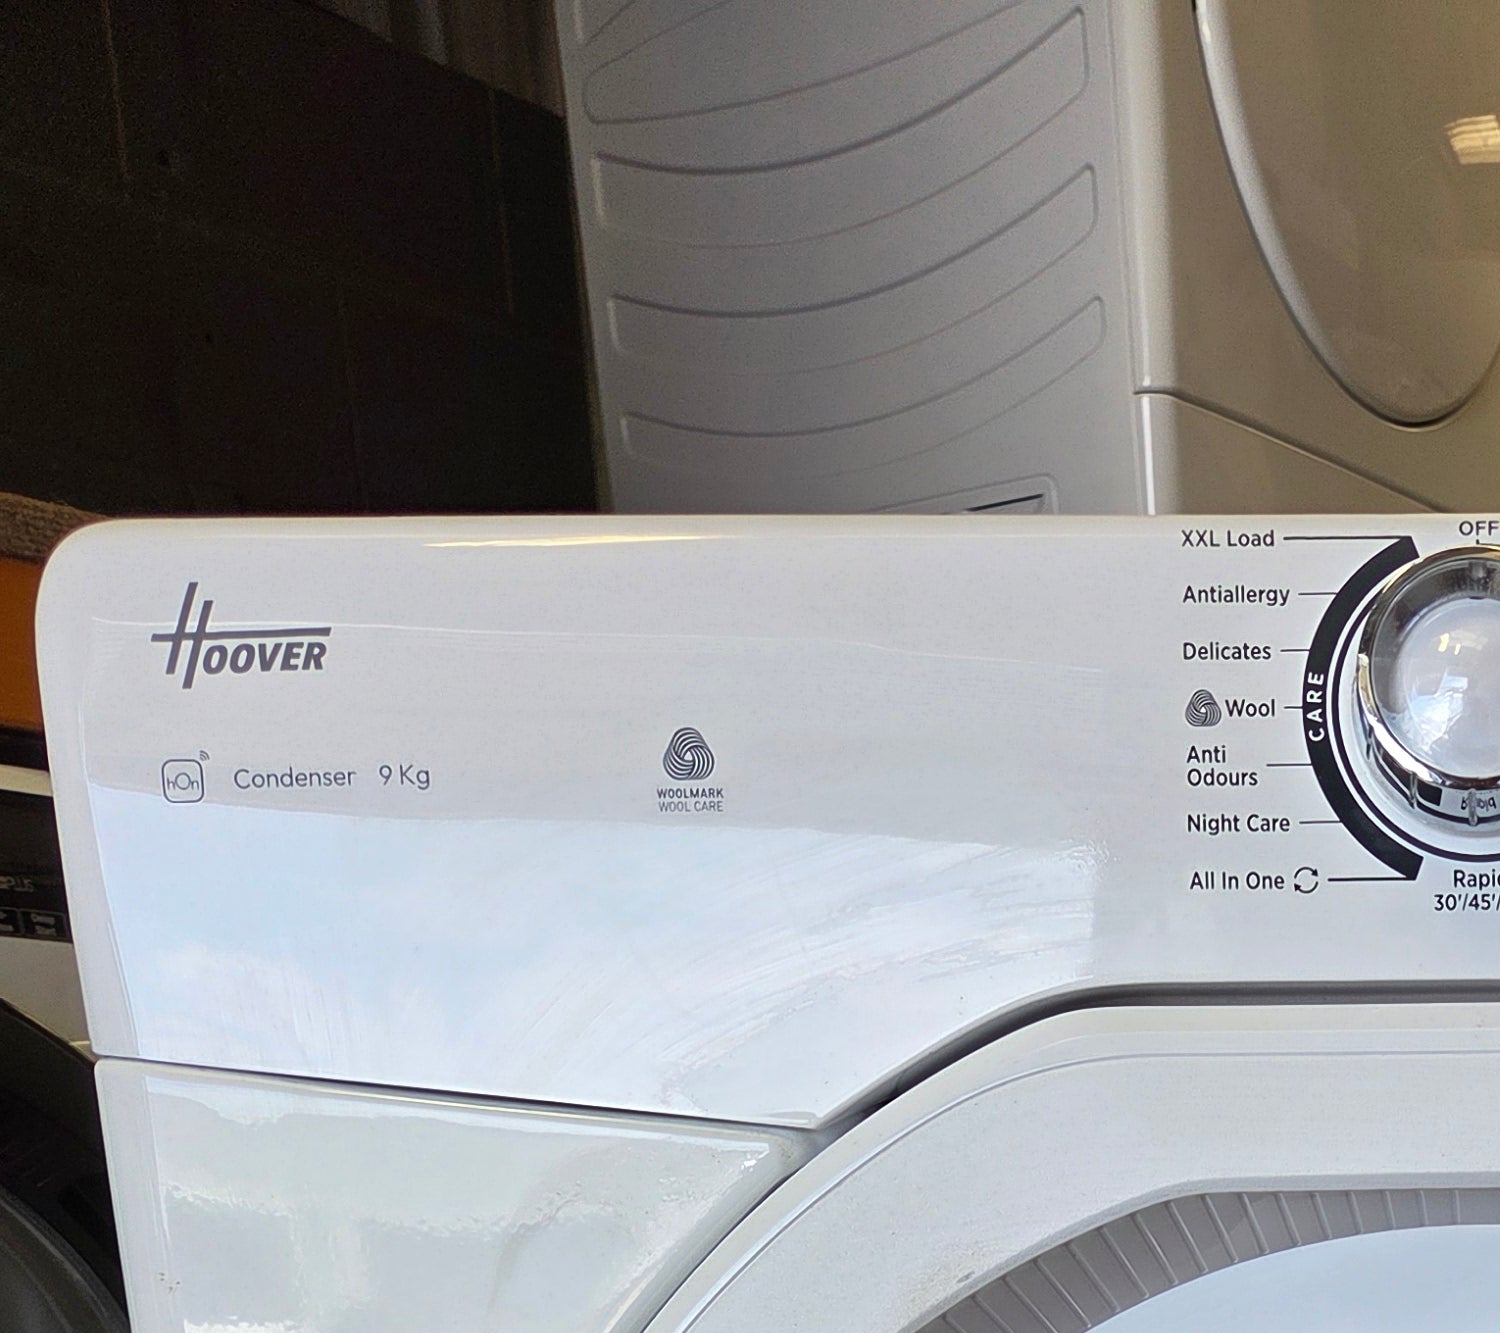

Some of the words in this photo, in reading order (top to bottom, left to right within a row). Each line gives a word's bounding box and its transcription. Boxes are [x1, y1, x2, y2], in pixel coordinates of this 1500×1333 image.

[1181, 529, 1220, 548] XXL
[1226, 529, 1275, 548] Load
[1458, 520, 1500, 537] OFF
[1182, 584, 1290, 607] Antiallergy
[150, 581, 332, 690] HOOVER
[1182, 641, 1272, 661] Delicates
[1224, 698, 1276, 718] Wool
[1306, 670, 1325, 742] CARE
[1186, 744, 1226, 764] Anti
[166, 771, 201, 792] hOn
[233, 765, 357, 790] Condenser
[378, 764, 393, 786] 9
[399, 764, 430, 791] Kg
[1187, 767, 1258, 787] Odours
[656, 787, 724, 800] WOOLMARK
[658, 800, 690, 813] WOOL
[693, 800, 724, 813] CARE
[1187, 813, 1241, 836] Night
[1246, 813, 1291, 833] Care
[1189, 871, 1215, 890] All
[1222, 871, 1238, 890] In
[1245, 871, 1285, 890] One
